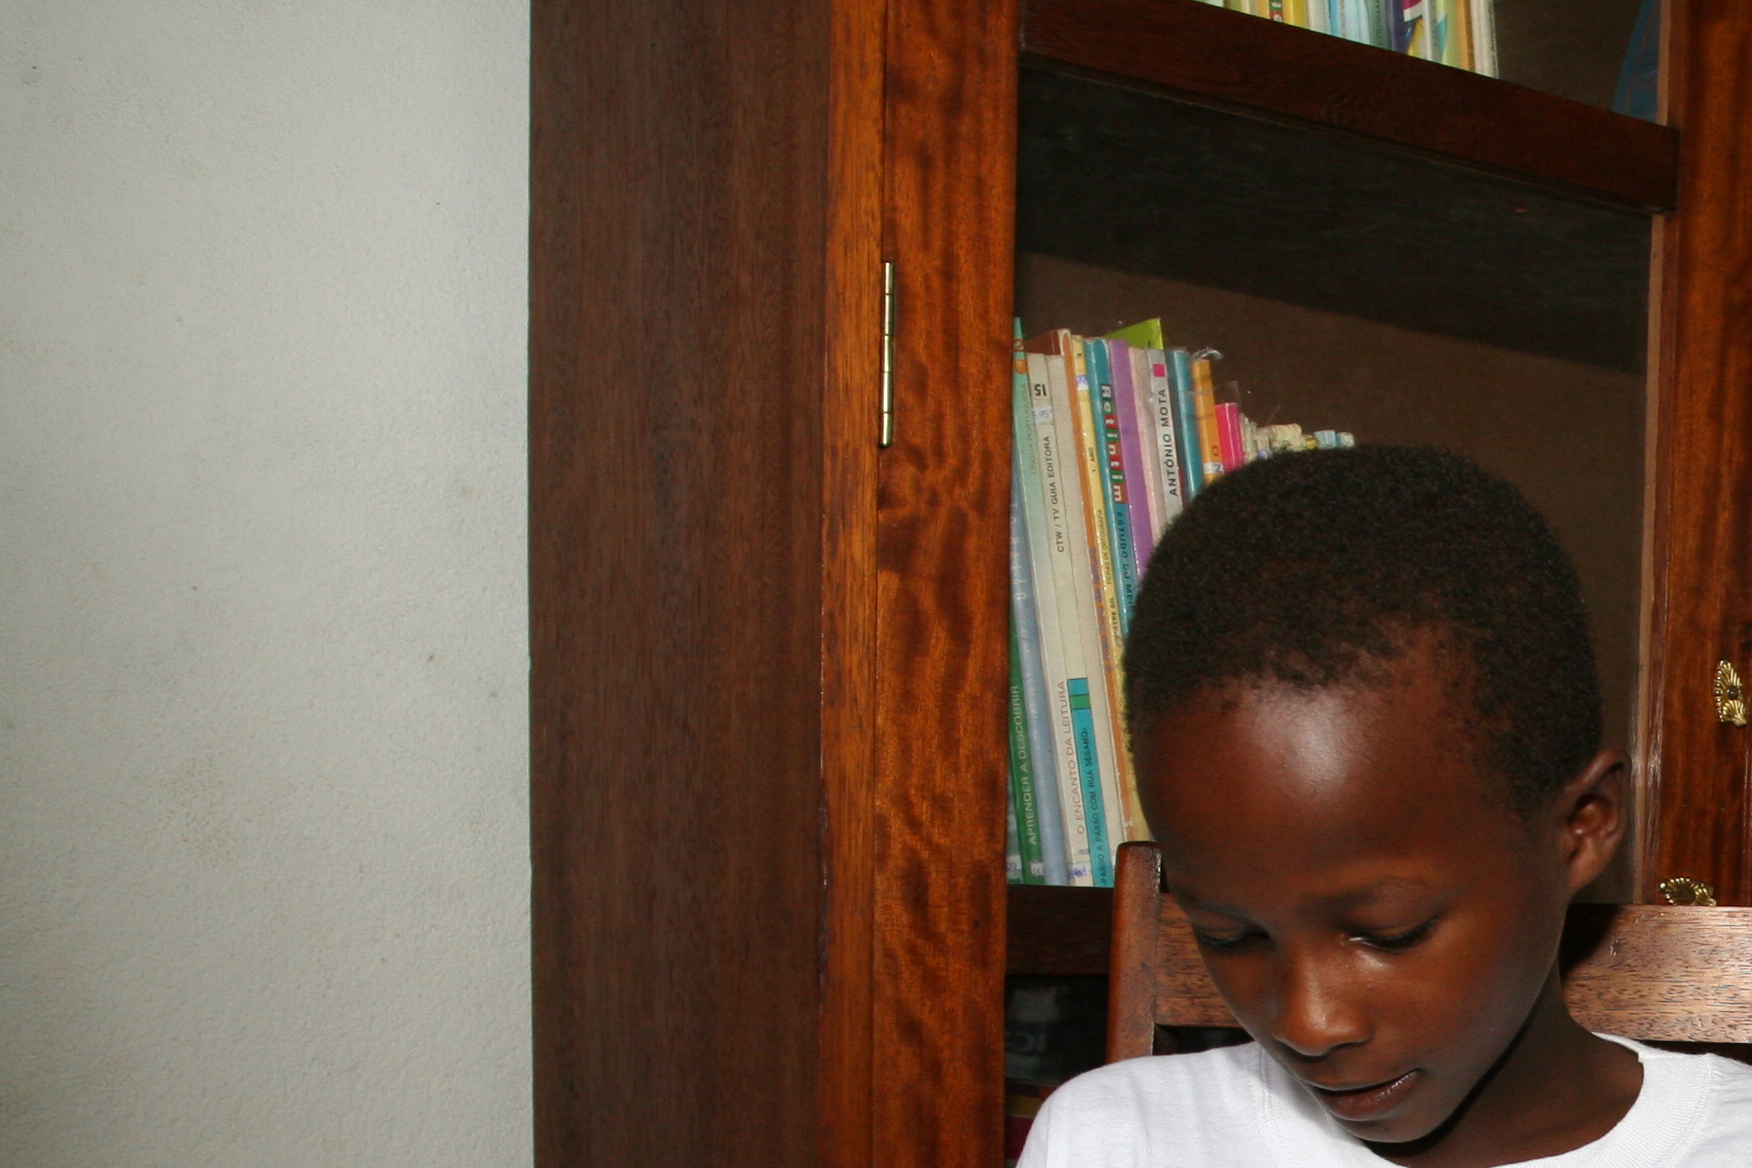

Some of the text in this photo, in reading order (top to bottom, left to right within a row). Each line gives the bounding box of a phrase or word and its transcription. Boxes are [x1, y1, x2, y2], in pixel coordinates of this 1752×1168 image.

[1033, 383, 1048, 397] 15
[1157, 388, 1179, 496] ANTÓNIO MOTA
[1042, 436, 1056, 478] EDITORA
[1050, 481, 1060, 505] GUIA
[1053, 508, 1061, 521] TV
[1055, 529, 1065, 553] CTW
[1011, 685, 1028, 760] DESCOBRIR
[1020, 763, 1029, 773] A
[1056, 680, 1086, 835] O ENCANTO DA LEITURA
[1087, 769, 1097, 789] RUA
[1021, 773, 1038, 846] APRENDER
[1090, 790, 1100, 810] COM
[1091, 812, 1102, 843] PASSO
